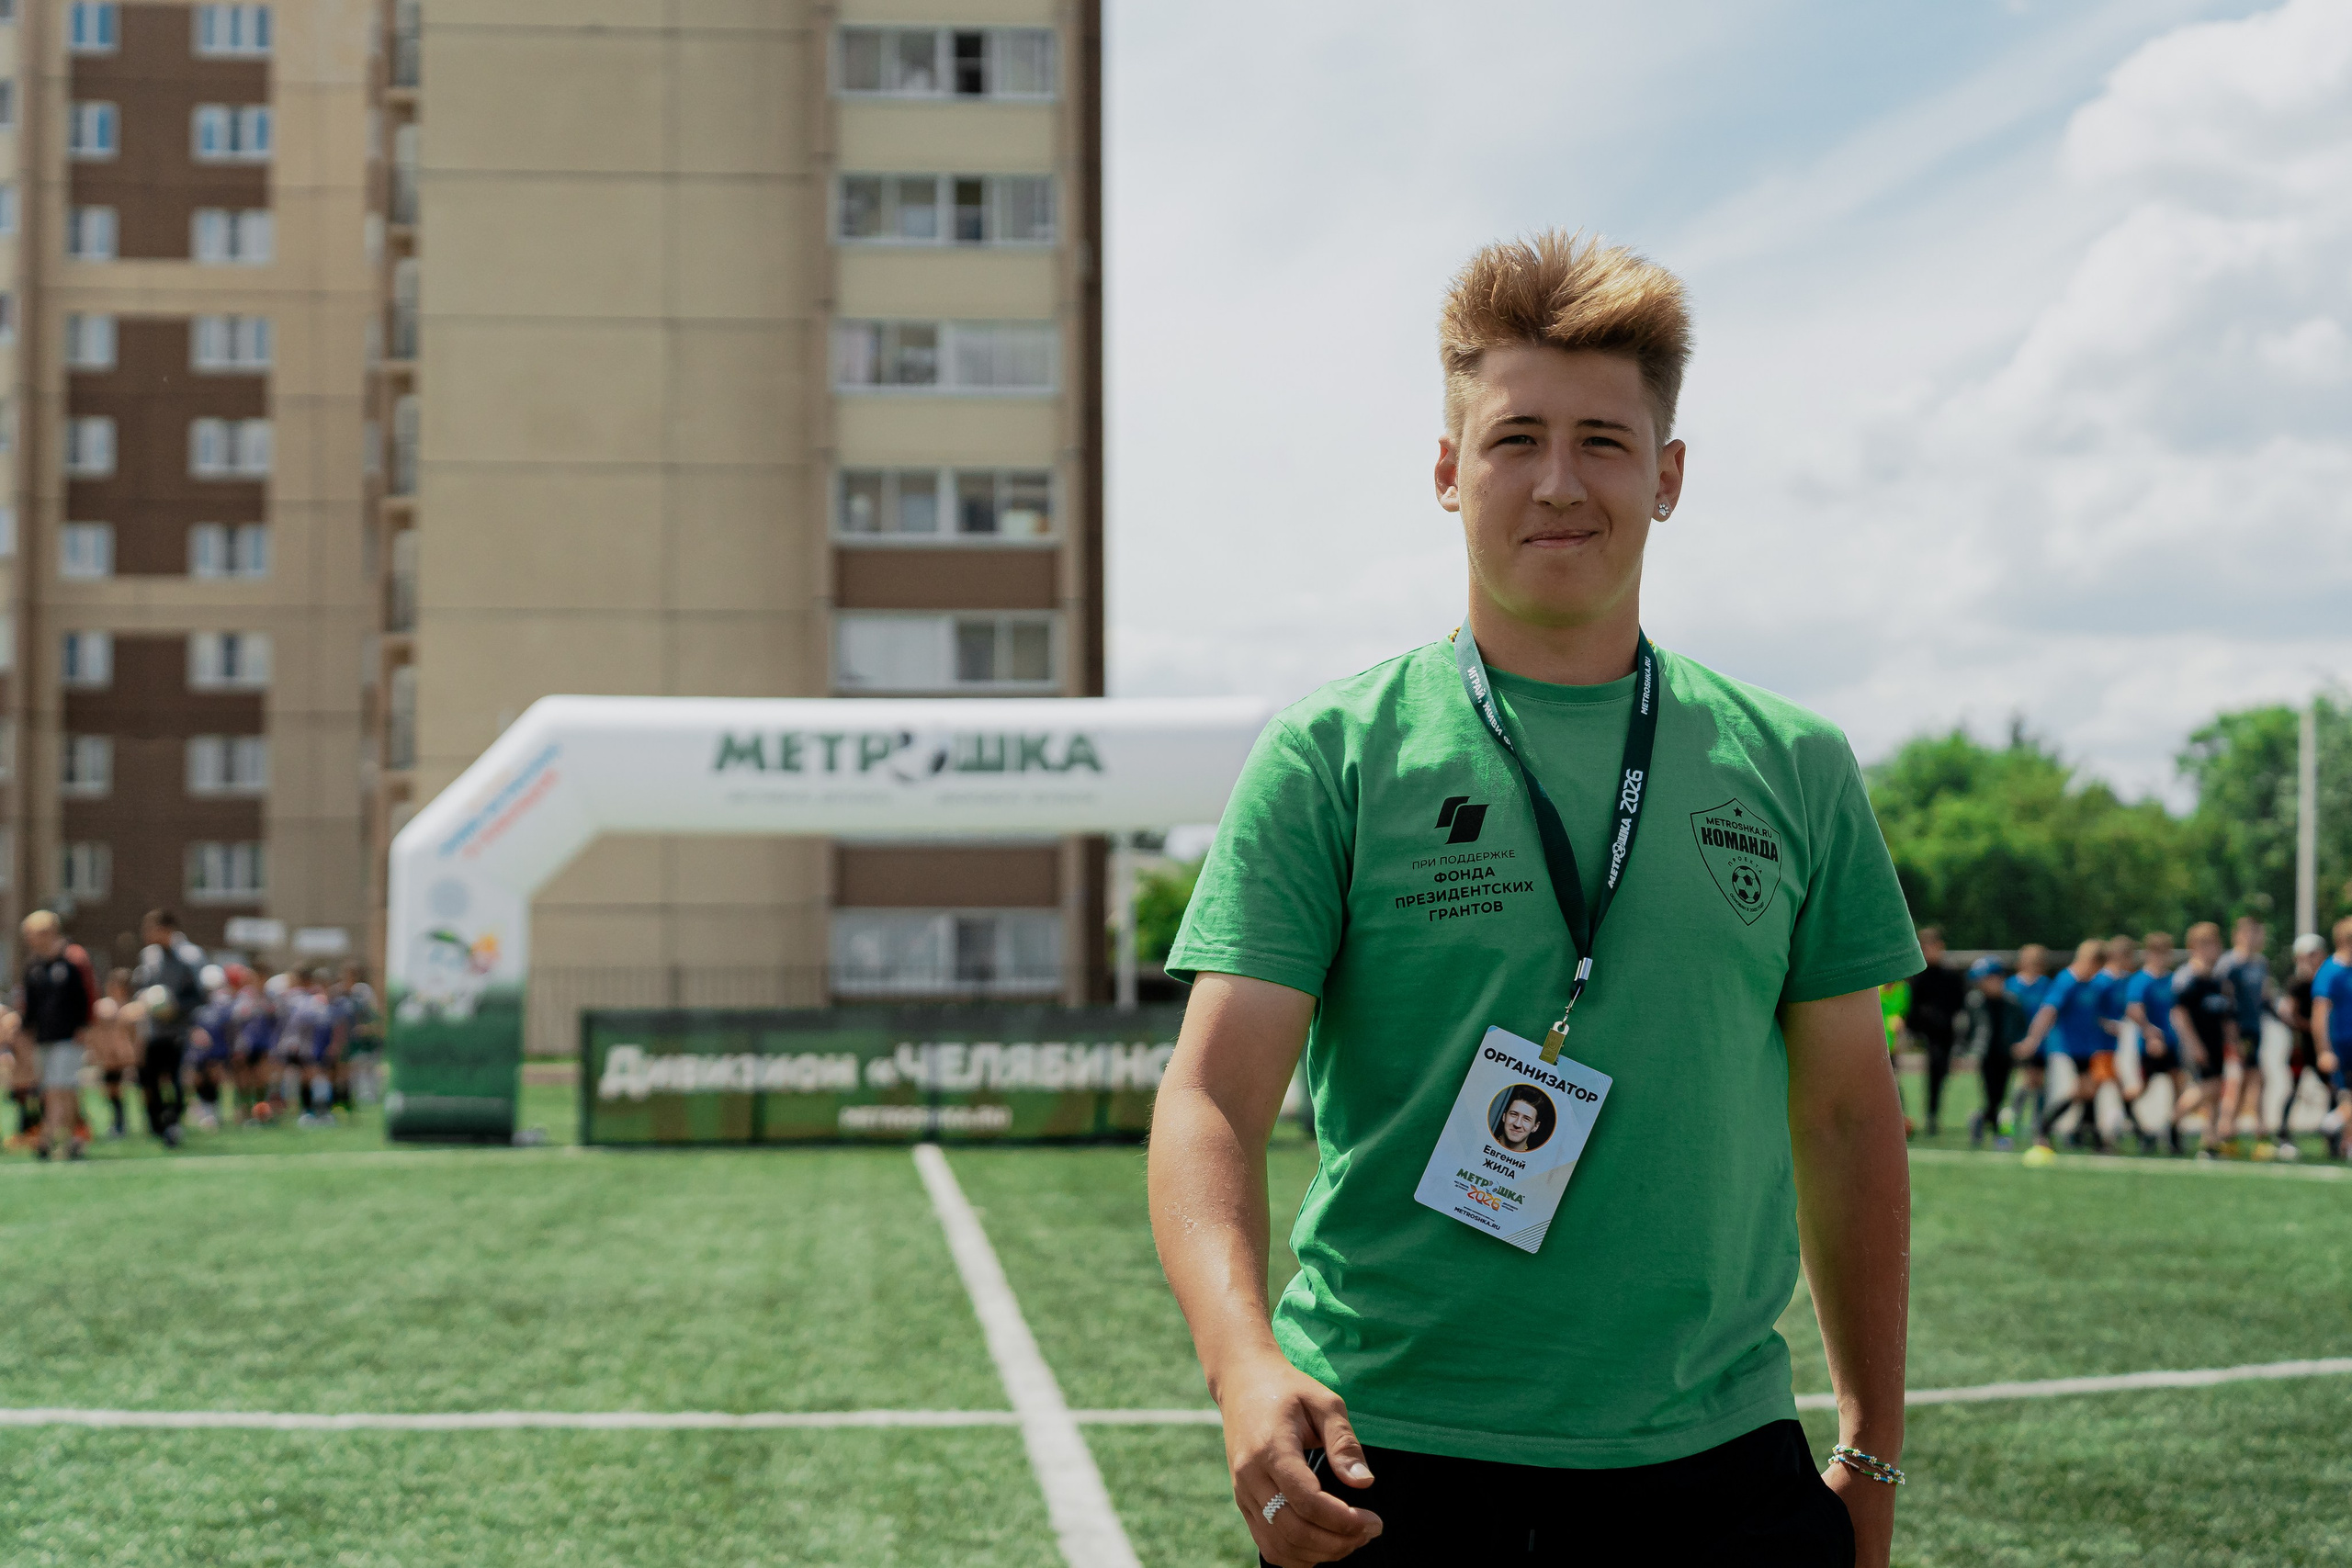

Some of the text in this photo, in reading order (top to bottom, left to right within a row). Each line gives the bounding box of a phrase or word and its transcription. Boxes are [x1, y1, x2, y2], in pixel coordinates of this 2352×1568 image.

[1641, 656, 1651, 715] METROSHKA.RU
[1467, 666, 1503, 736] ИГРАЙ, ЖИВИ
[1608, 769, 1644, 889] МЕТРОШКА 2026
[1706, 817, 1772, 839] METROSHKA.RU
[1701, 827, 1779, 863] КОМАНДА
[1412, 850, 1516, 870] ПРИ ПОДДЕРЖКЕ
[1727, 856, 1763, 874] ПРОЕКТА
[1433, 866, 1496, 884] ФОНДА
[1395, 881, 1534, 909] ПРЕЗИДЕНТСКИХ
[1429, 901, 1504, 922] ГРАНТОВ
[1484, 1047, 1599, 1104] ОРГАНИЗАТОР
[1482, 1158, 1516, 1180] ЖИЛА
[1483, 1145, 1526, 1170] Евгений
[1467, 1184, 1501, 1212] 2026
[1453, 1206, 1501, 1231] METROSHKA.RU
